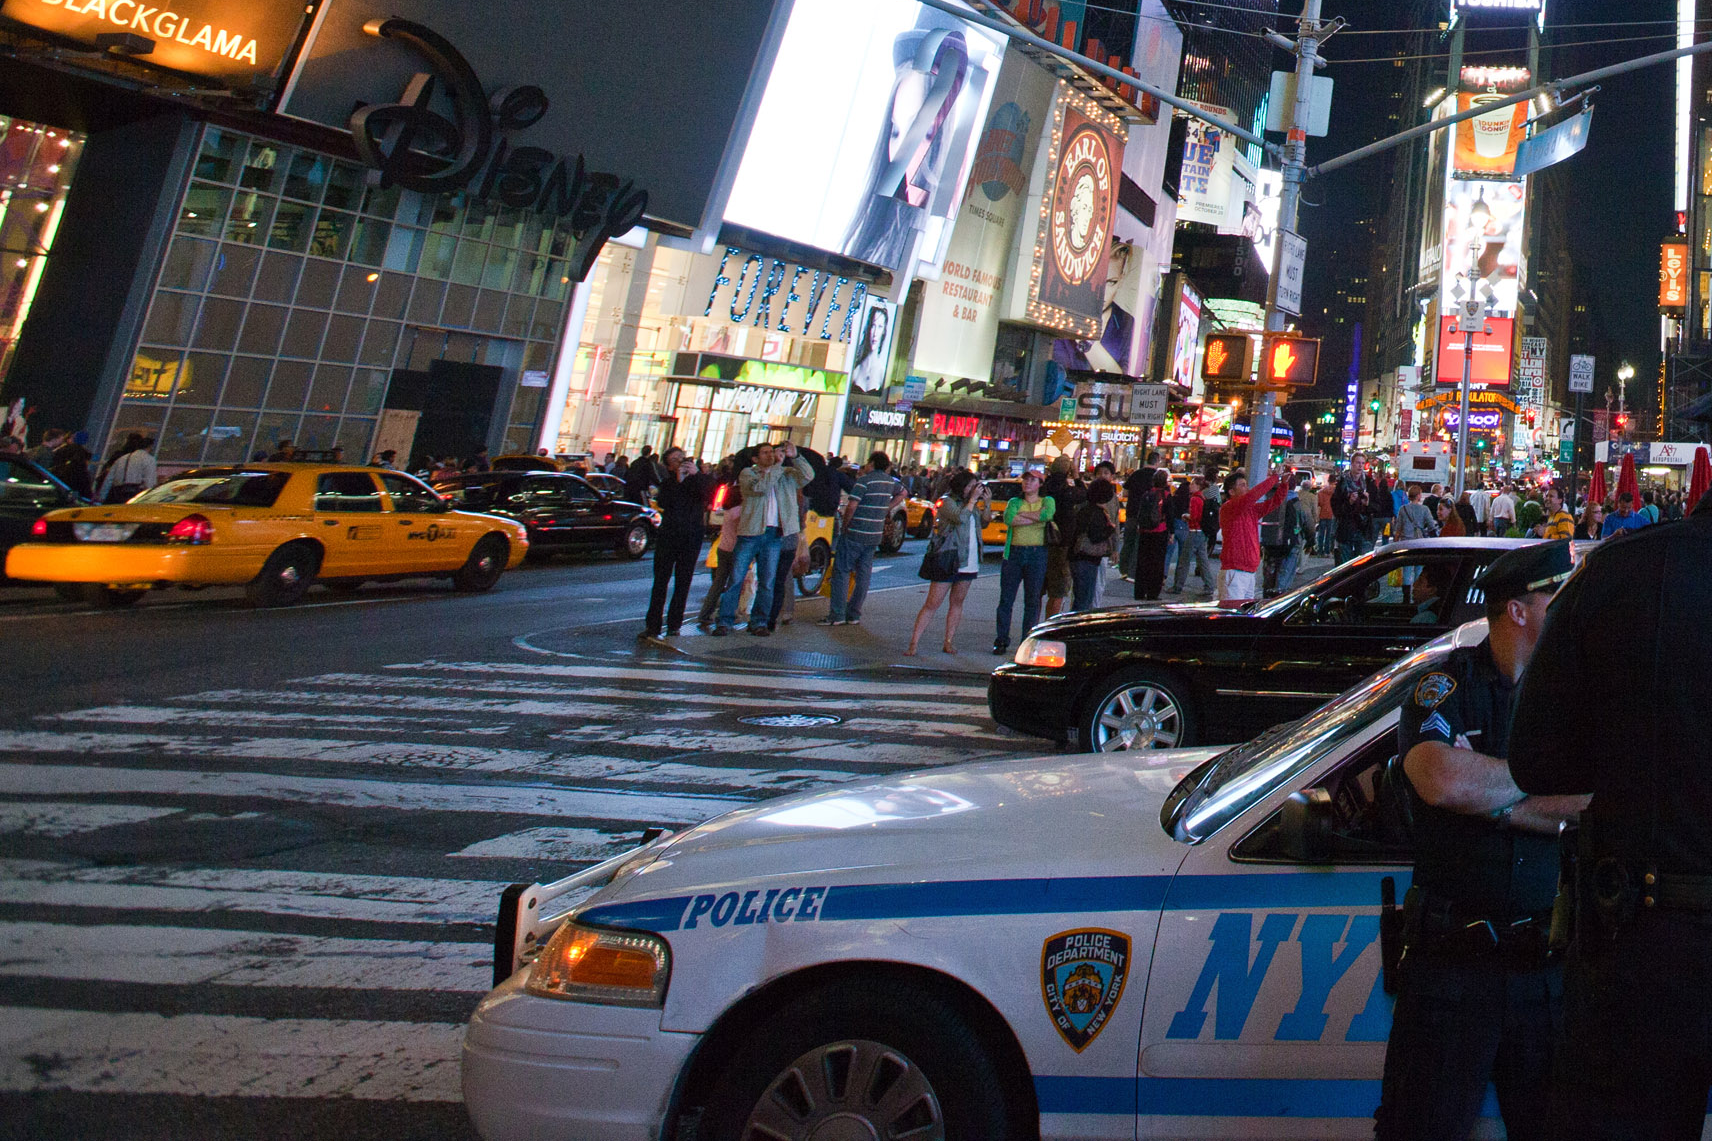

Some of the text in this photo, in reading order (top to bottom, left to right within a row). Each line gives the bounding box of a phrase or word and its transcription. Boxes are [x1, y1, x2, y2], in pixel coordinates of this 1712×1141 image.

[1065, 138, 1108, 191] EARL OF
[969, 204, 1005, 227] TIMES SQUARE
[1055, 211, 1104, 279] SANDWICH
[973, 268, 1002, 290] FAMOUS
[705, 247, 868, 344] FOREVER
[943, 281, 993, 307] RESTAURANT
[953, 304, 978, 323] & BAR
[1573, 373, 1591, 381] WALK
[729, 385, 816, 418] FOREVER 21
[1134, 388, 1166, 397] RIGHT LANE
[1139, 400, 1158, 409] MUST
[933, 413, 979, 437] PLANET
[1149, 413, 1165, 421] RIGHT
[684, 886, 827, 930] POLICE
[1066, 934, 1112, 949] POLICE
[1047, 946, 1125, 970] DEPARTMENT
[1046, 974, 1123, 1036] CITY OF NEW YORK
